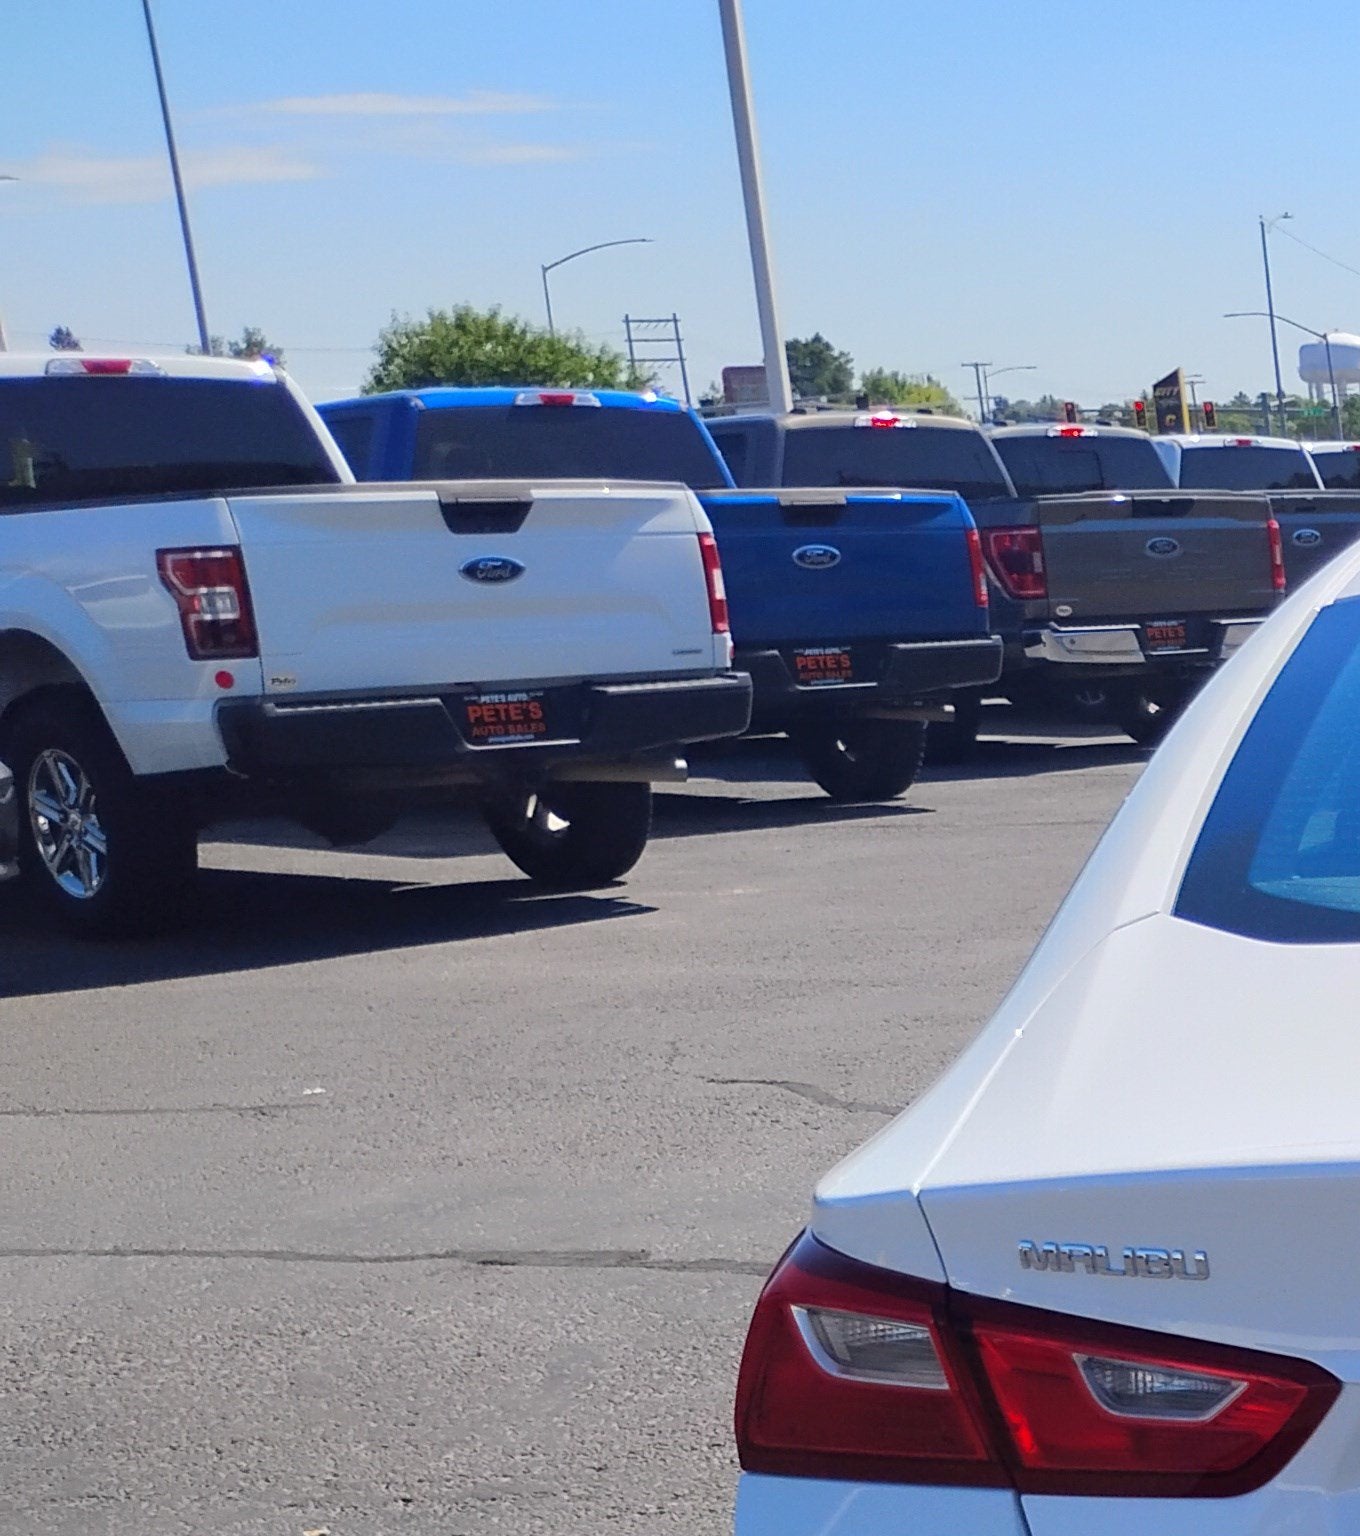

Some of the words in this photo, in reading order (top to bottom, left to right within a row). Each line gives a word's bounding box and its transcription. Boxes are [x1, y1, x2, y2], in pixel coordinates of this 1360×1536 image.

[796, 654, 851, 669] PETE'S
[467, 702, 543, 723] PETE'S
[472, 725, 505, 737] AUTO
[1018, 1239, 1210, 1281] MALIBU
